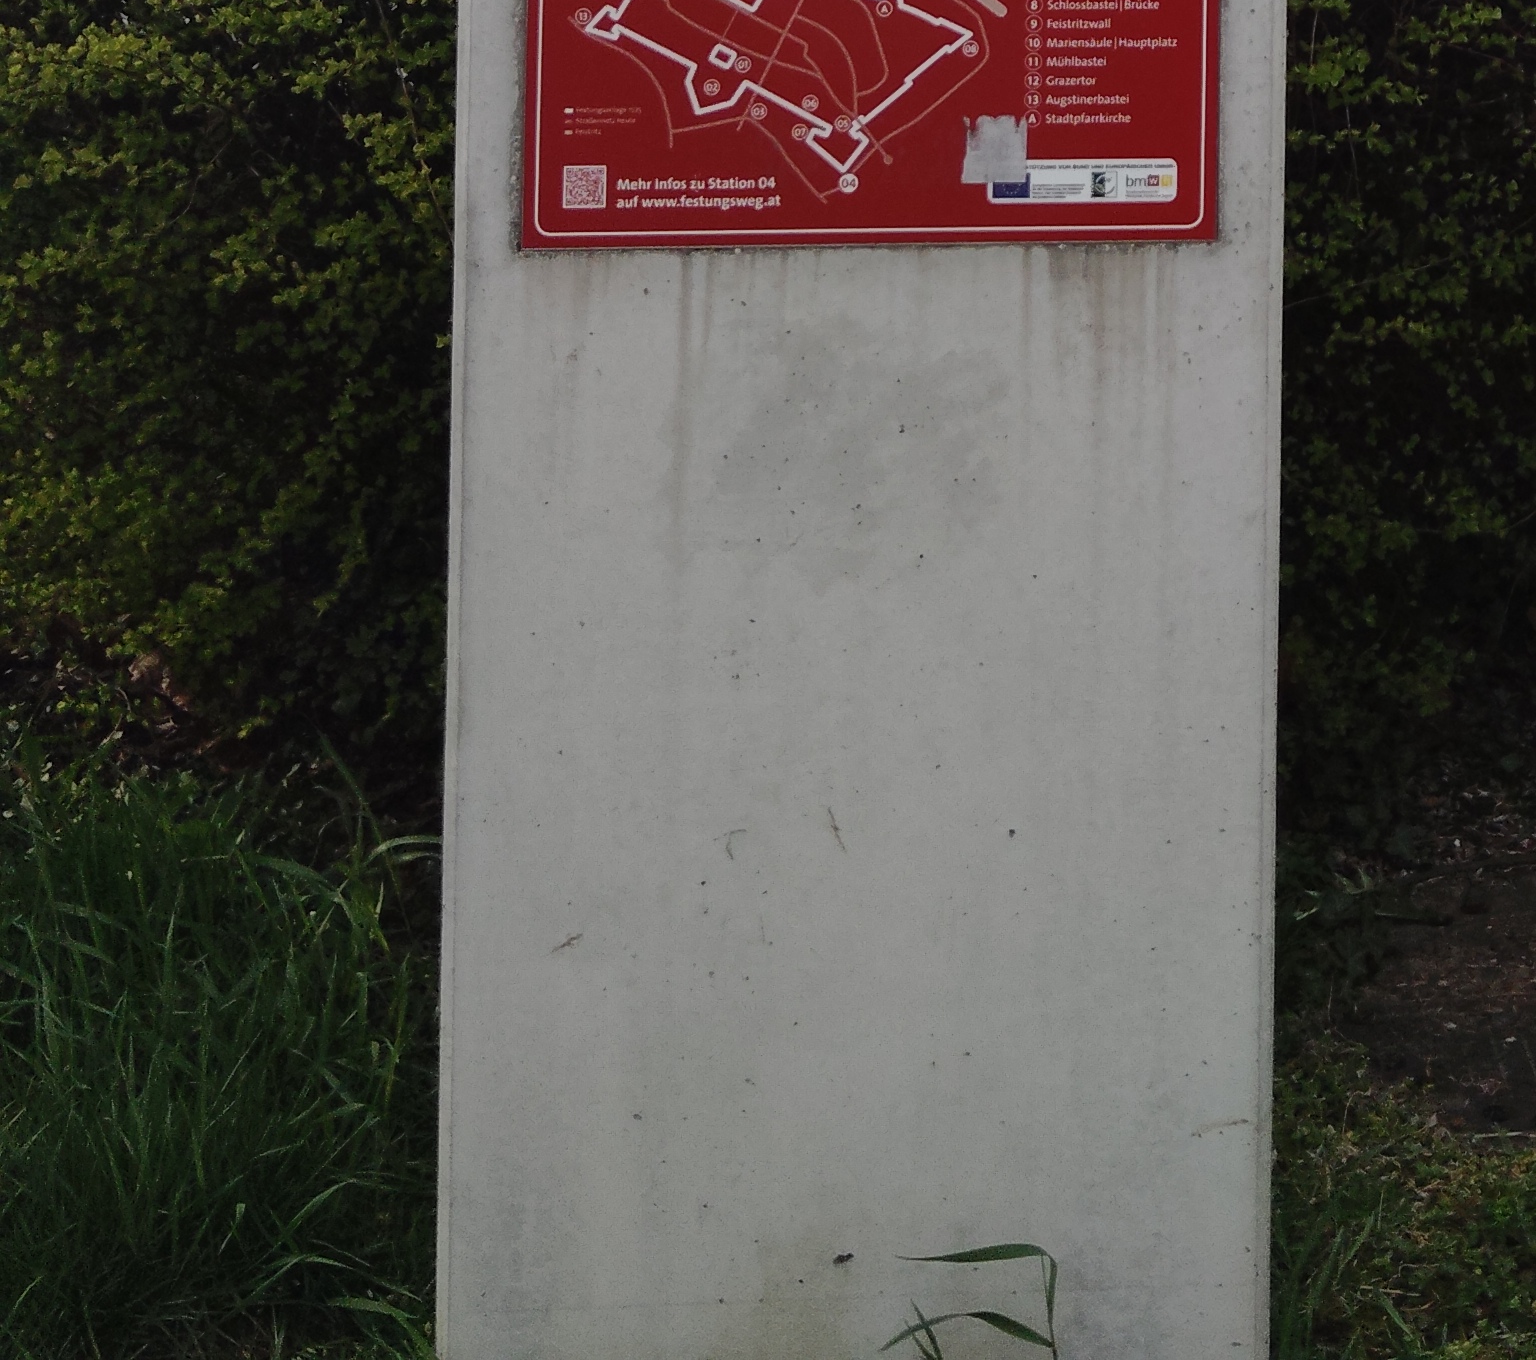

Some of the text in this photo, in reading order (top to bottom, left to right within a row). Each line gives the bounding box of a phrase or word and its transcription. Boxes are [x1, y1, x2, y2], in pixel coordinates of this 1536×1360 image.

[1047, 18, 1111, 29] Feistritzwall
[1047, 56, 1106, 67] Mühlbastei
[1046, 76, 1096, 86] Grazertor
[1046, 113, 1131, 126] Stadtpfarrkirche
[617, 177, 776, 192] Mehr Infos zu Station 04
[616, 195, 781, 210] auf www.festungsweg.at
